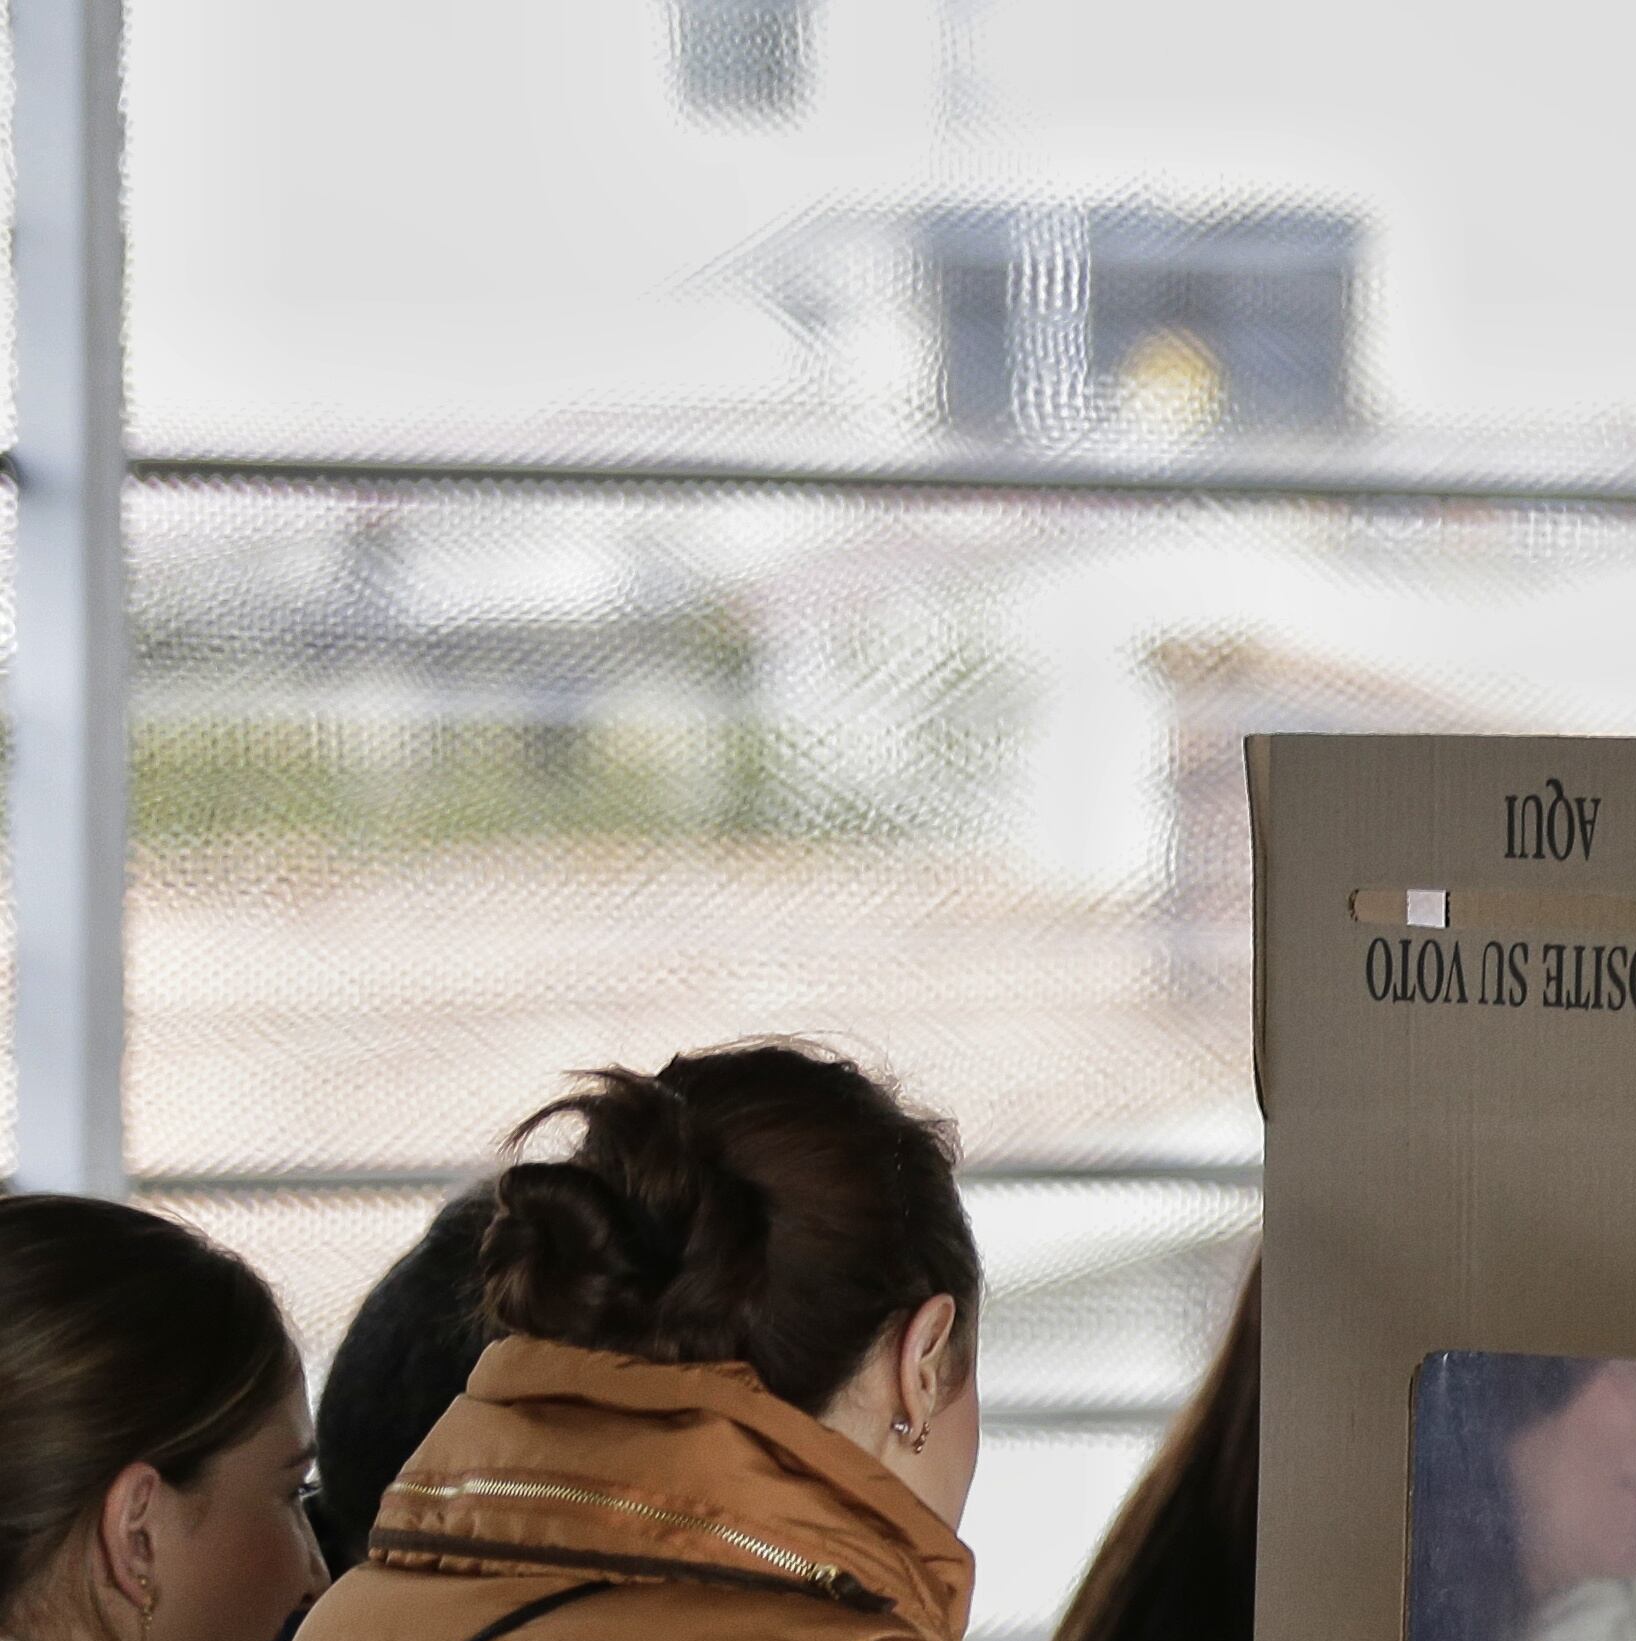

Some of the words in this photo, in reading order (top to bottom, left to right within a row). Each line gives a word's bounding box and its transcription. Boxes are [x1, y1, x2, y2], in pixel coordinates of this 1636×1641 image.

[1505, 778, 1603, 863] AQUI
[1366, 937, 1469, 1005] VOTO
[1478, 941, 1530, 1009] SU
